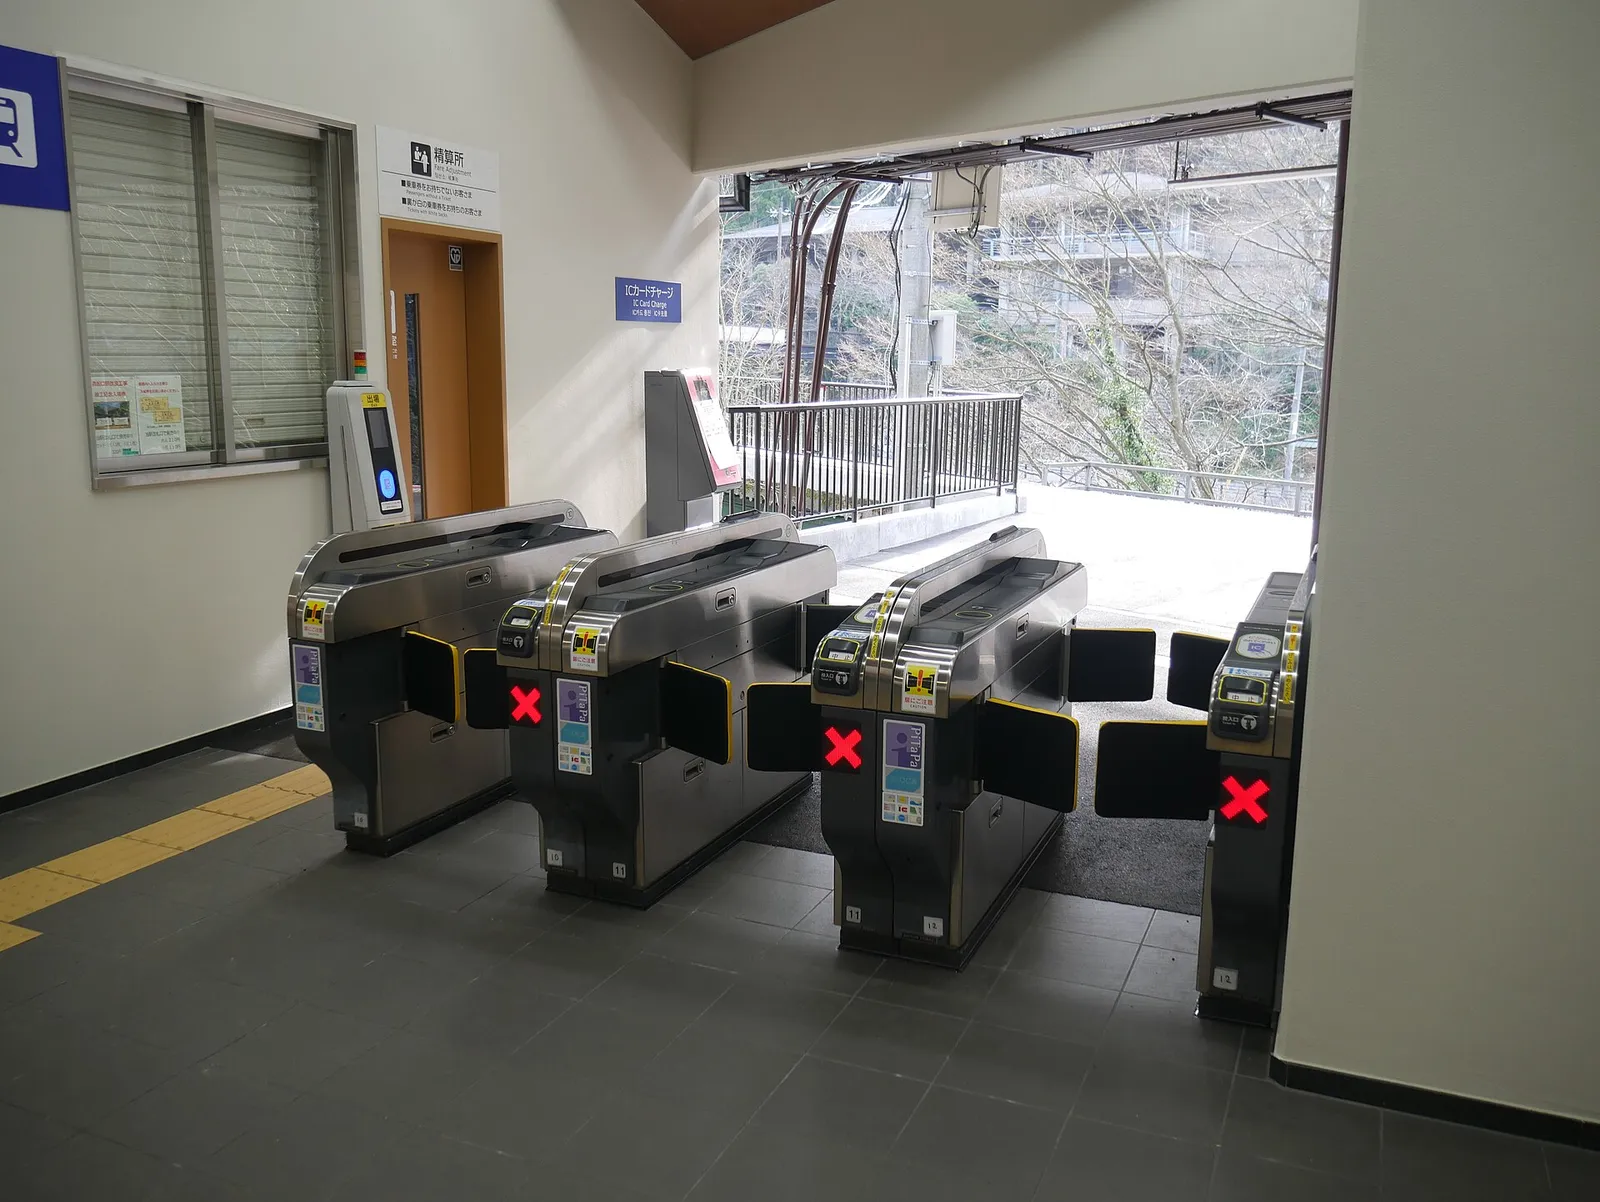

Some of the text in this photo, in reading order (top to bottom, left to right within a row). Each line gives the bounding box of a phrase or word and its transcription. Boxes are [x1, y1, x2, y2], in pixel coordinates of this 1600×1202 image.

[434, 147, 464, 168] 精算所
[625, 284, 674, 299] ICカードチャージ
[633, 299, 667, 310] IC Card Charge
[310, 650, 318, 684] PiTaPa
[578, 685, 588, 722] PiTaPa
[910, 727, 921, 768] PiTaPa
[615, 866, 625, 876] 11
[849, 910, 859, 920] 11
[928, 922, 938, 930] 12
[1220, 975, 1232, 984] 12
